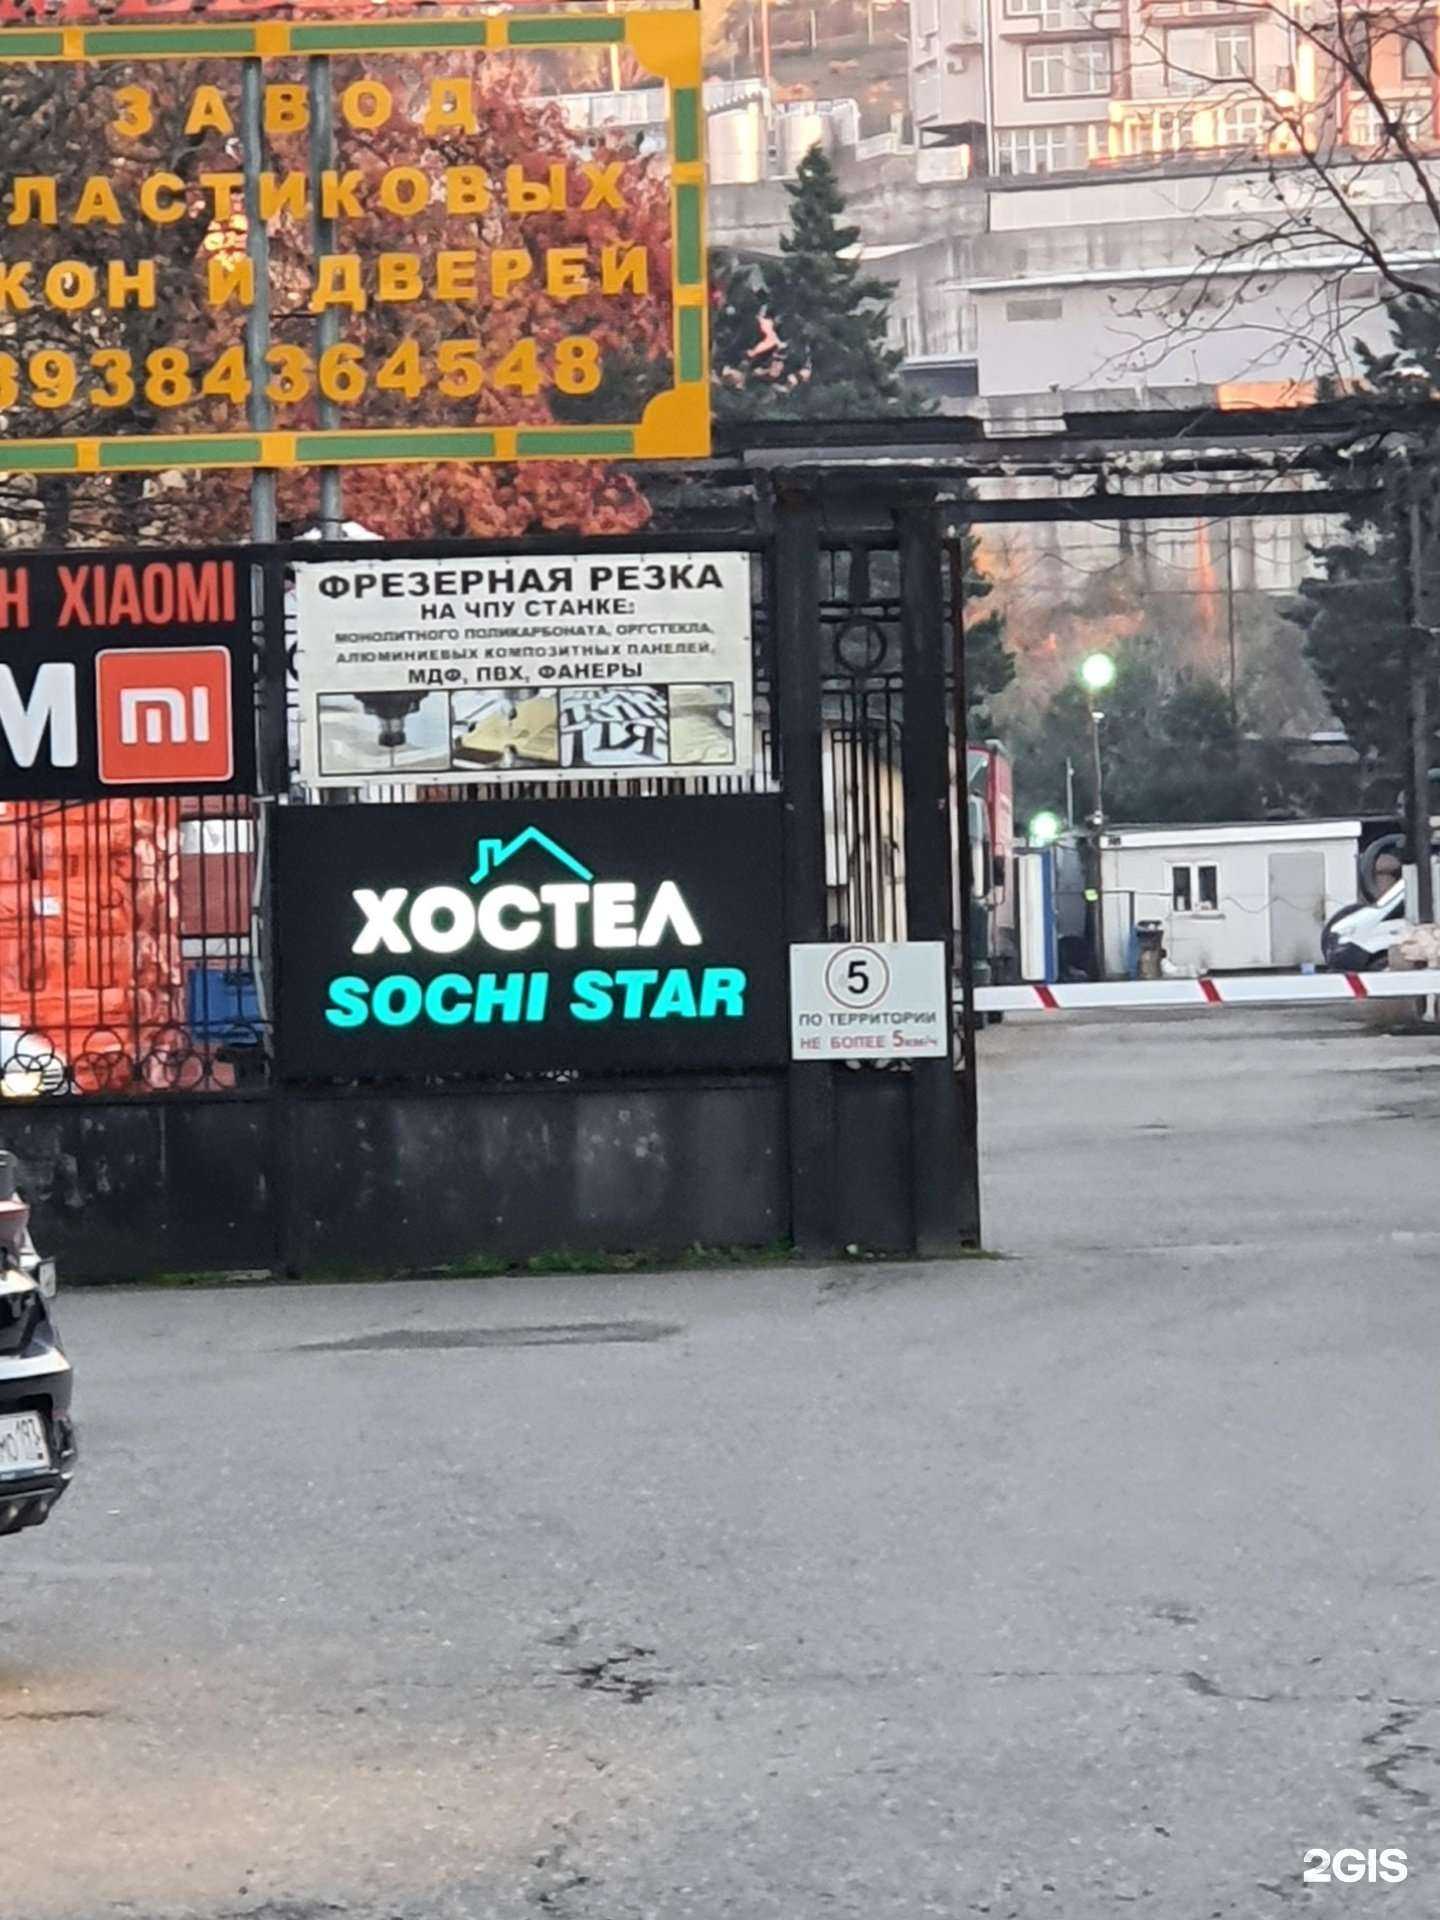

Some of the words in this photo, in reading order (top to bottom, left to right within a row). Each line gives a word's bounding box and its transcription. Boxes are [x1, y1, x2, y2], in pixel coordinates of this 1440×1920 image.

[112, 76, 480, 137] ЗАВОД
[8, 161, 627, 226] ЛАСТИКОВЫХ
[0, 258, 156, 310] КОН
[208, 257, 255, 308] И
[310, 241, 649, 313] ДВЕРЕЙ
[57, 560, 236, 627] XIAOMI
[318, 567, 573, 599] ФРЕЗЕРНАЯ
[590, 563, 724, 592] РЕЗКА
[420, 603, 456, 620] НА
[465, 600, 515, 618] ЧПУ
[525, 598, 636, 617] СТАНКЕ:
[335, 628, 459, 644] МОНОЛИТНОГО
[464, 624, 612, 640] ПОЛИКАРБОНАТА,
[616, 622, 715, 636] ОРГСТЕКЛА,
[336, 648, 478, 663] АЛЮМИНИЕВЫХ
[485, 644, 621, 659] КОМПОЗИТНЫХ
[408, 667, 468, 685] МДФ,
[477, 665, 530, 684] ПВХ,
[538, 662, 643, 680] ФАНЕРЫ
[351, 880, 702, 954] ХОСТЕЛ
[848, 960, 870, 994] 5
[325, 971, 550, 1028] SOCHI
[569, 967, 746, 1021] STAR
[799, 1013, 822, 1027] ПО
[829, 1011, 937, 1026] ТЕРРИТОРИИ
[800, 1036, 821, 1049] НЕ
[830, 1034, 886, 1049] БОЛЕЕ
